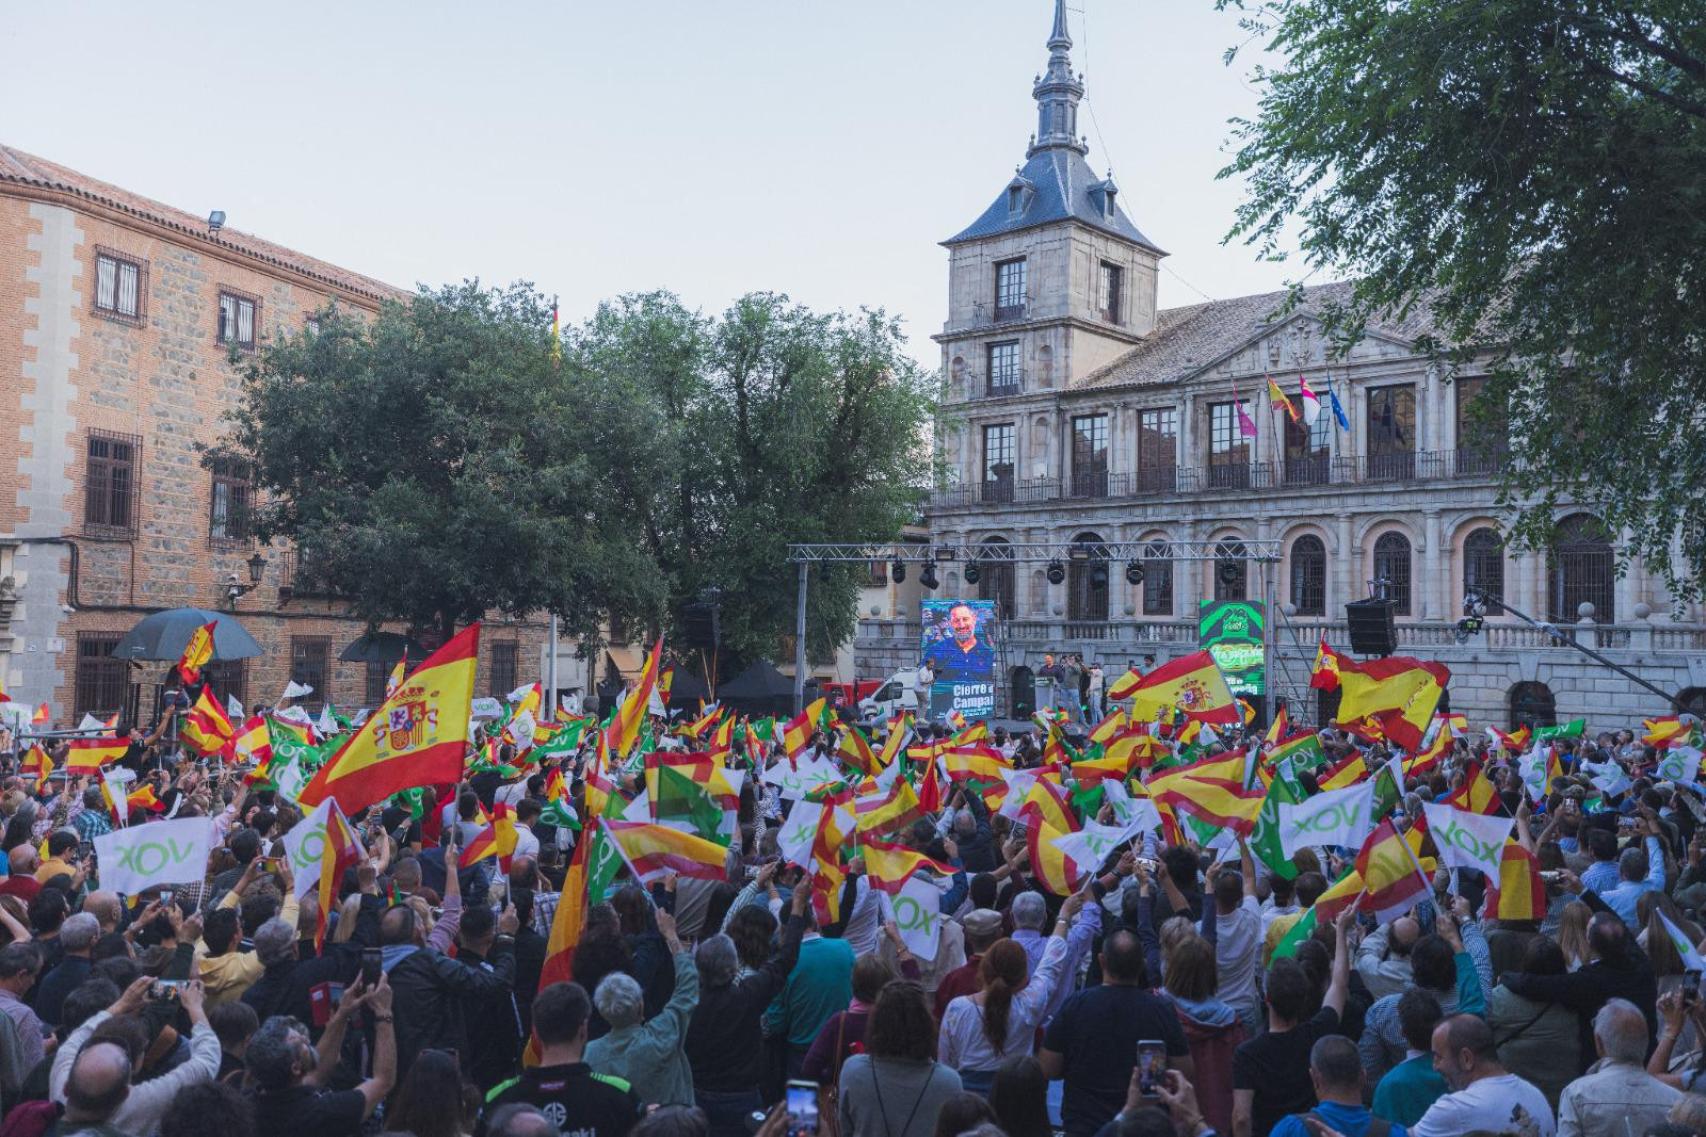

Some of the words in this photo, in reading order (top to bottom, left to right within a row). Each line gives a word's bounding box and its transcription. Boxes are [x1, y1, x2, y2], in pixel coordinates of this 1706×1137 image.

[953, 684, 987, 697] Cierre
[953, 696, 994, 709] Campa
[1432, 820, 1503, 867] VOX
[892, 896, 937, 937] OX
